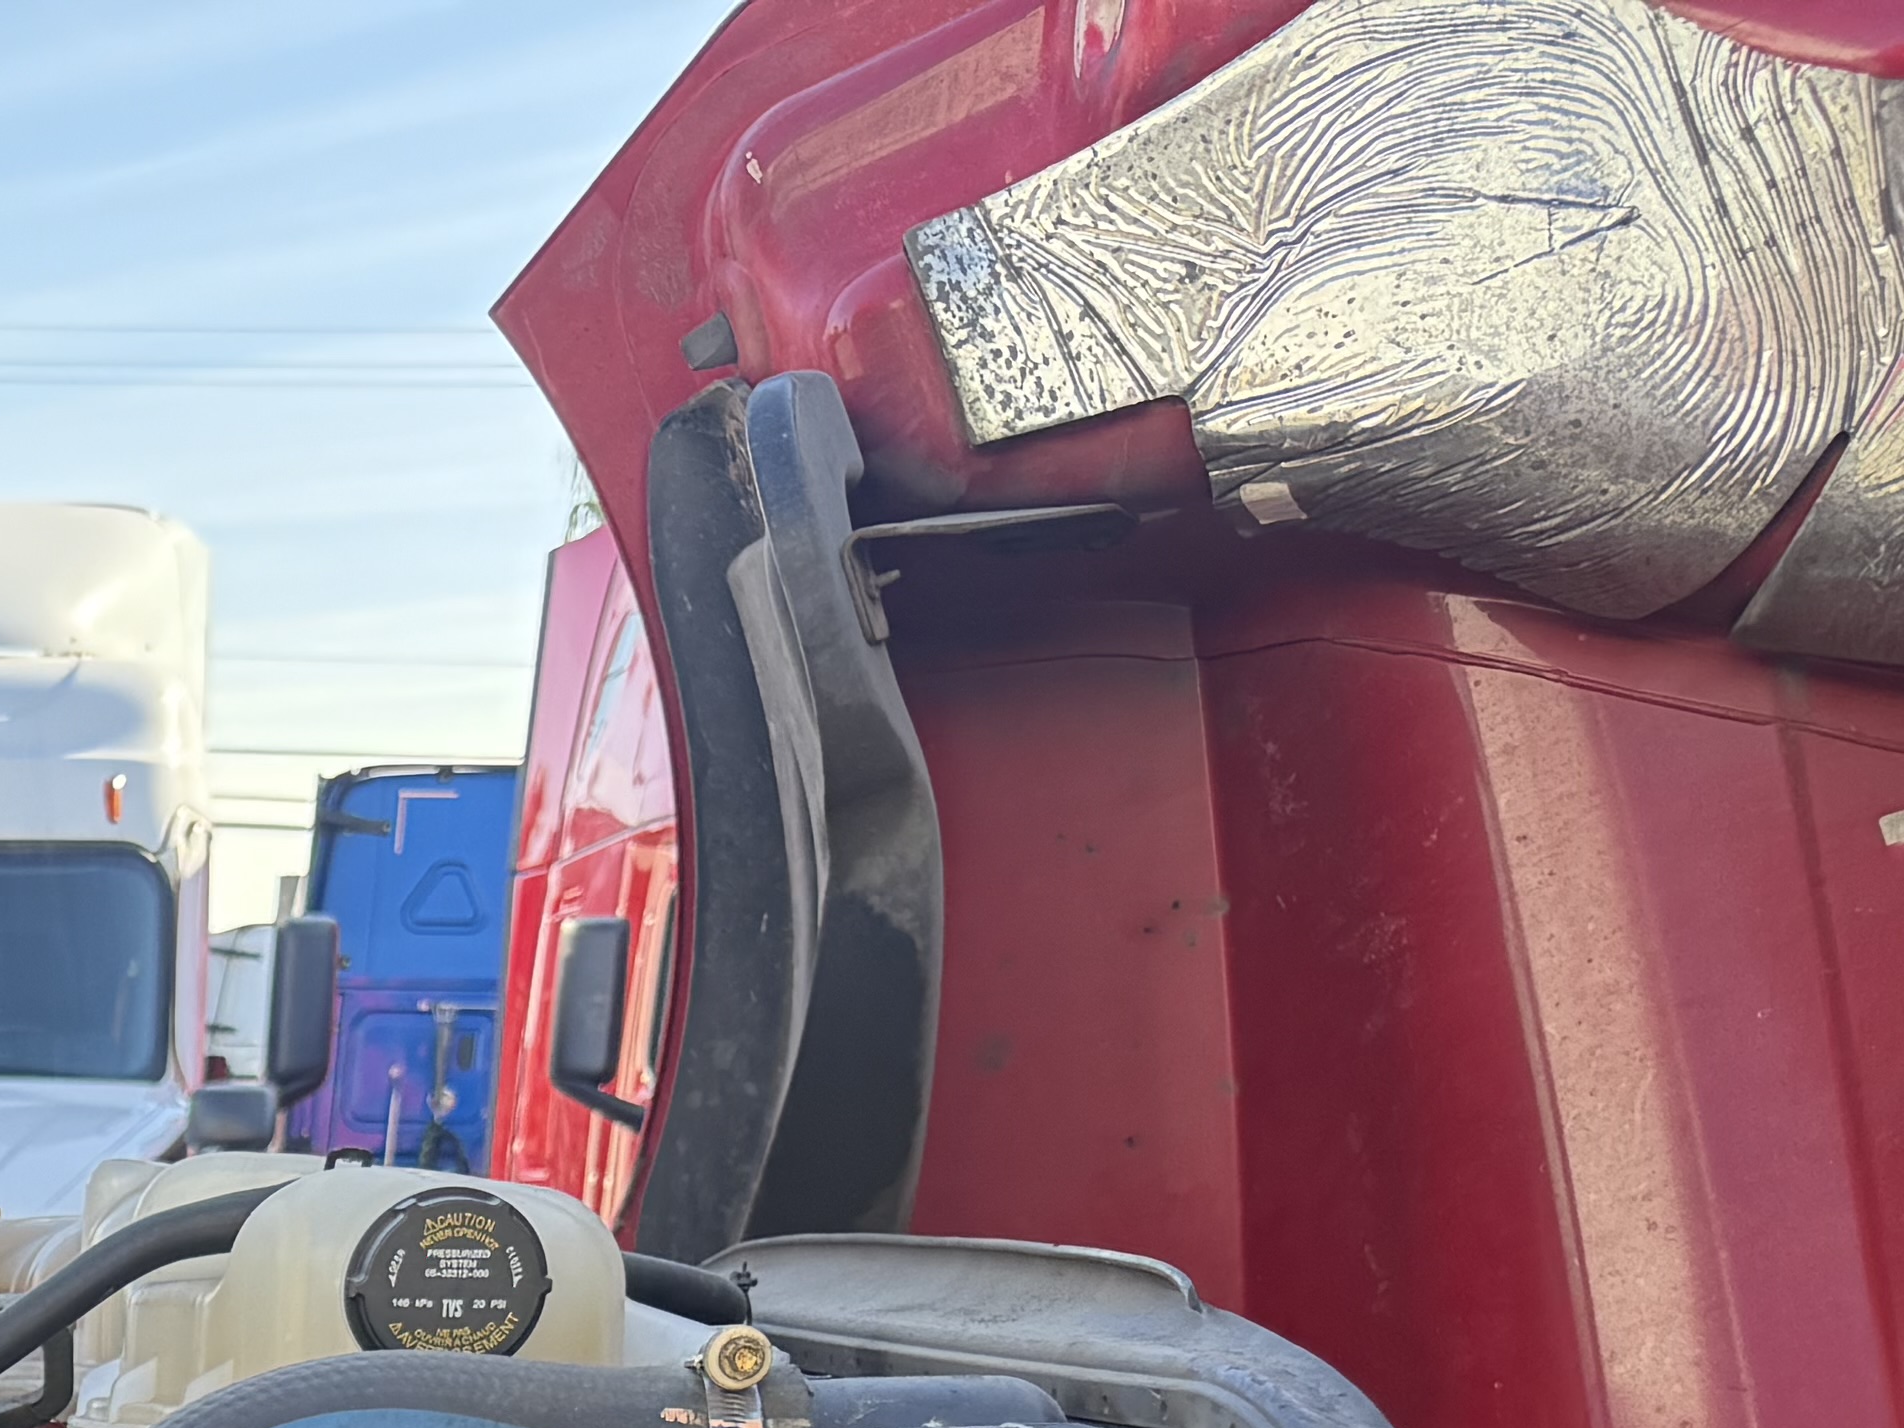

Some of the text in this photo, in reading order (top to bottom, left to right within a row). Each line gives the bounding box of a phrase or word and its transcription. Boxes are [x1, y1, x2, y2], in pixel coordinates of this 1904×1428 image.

[436, 1213, 496, 1232] CAUTION
[442, 1300, 463, 1318] TVS
[490, 1299, 507, 1309] PSI
